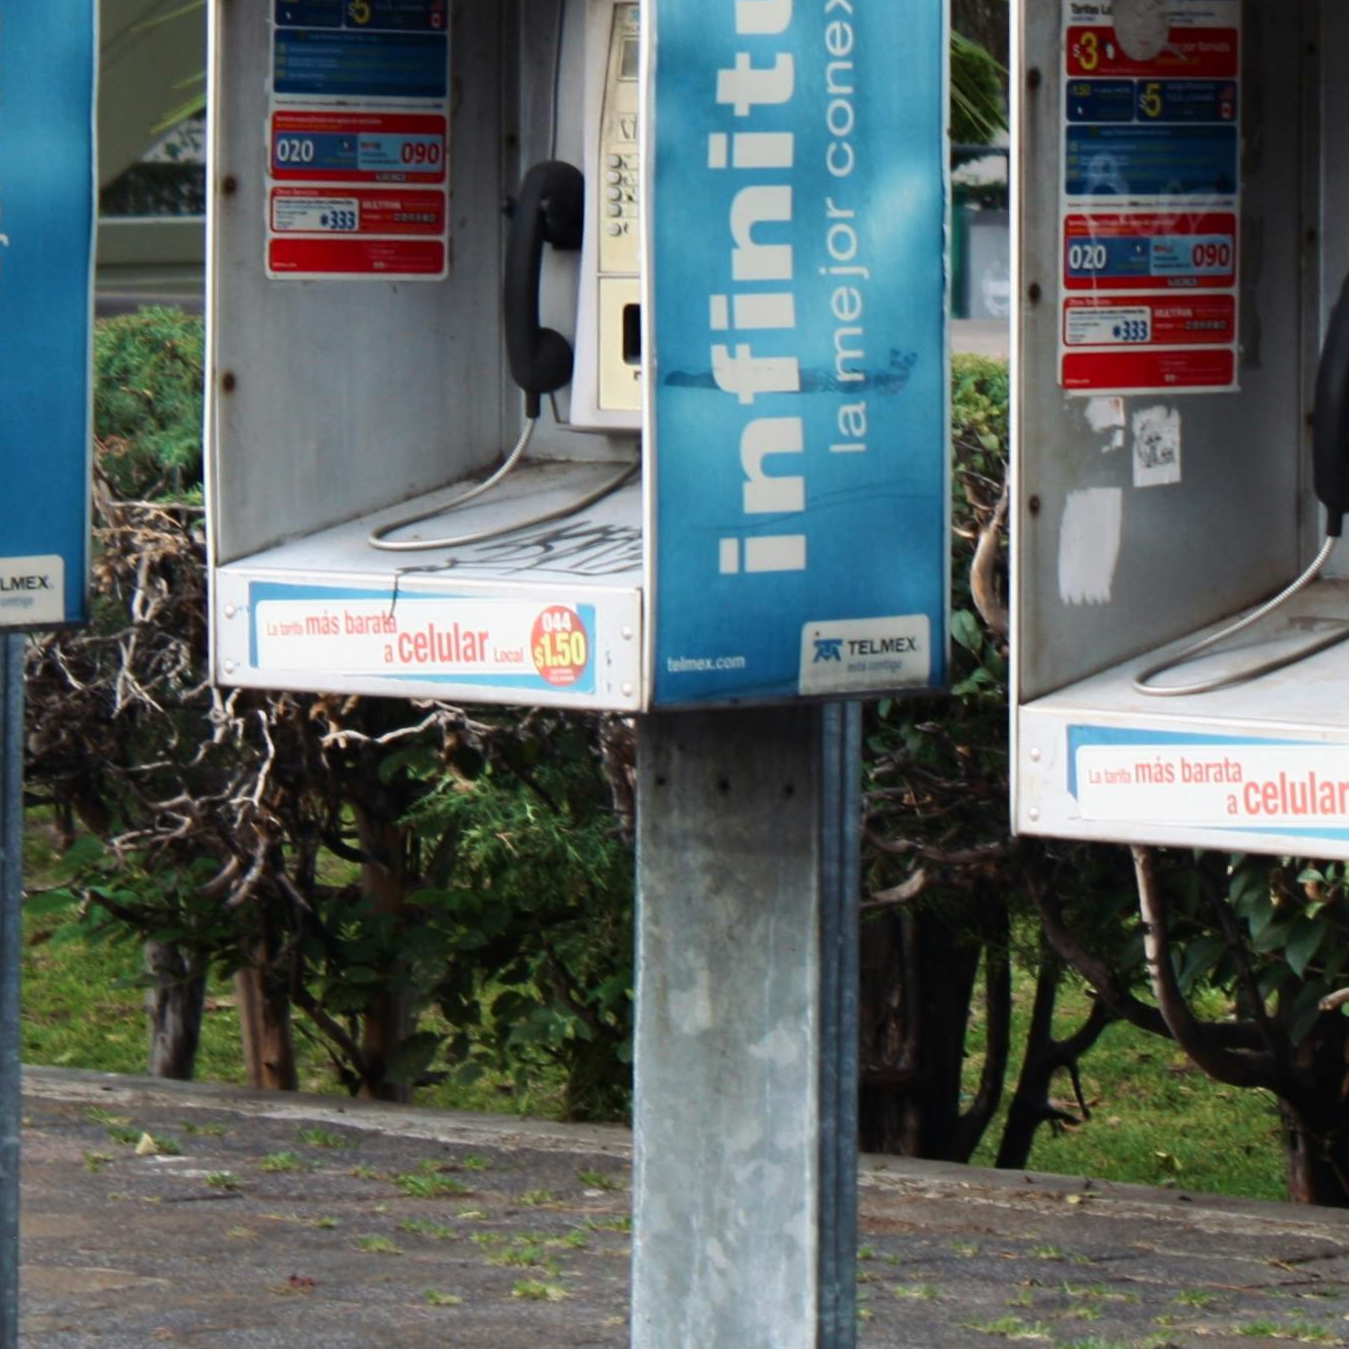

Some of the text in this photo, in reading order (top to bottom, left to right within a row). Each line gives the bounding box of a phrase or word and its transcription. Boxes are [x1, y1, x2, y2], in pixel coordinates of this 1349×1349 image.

[277, 139, 314, 162] 020
[402, 142, 440, 164] 090
[1069, 244, 1106, 270] 020
[1193, 243, 1231, 268] 090
[819, 196, 869, 382] mejor
[830, 402, 867, 453] la
[305, 610, 340, 635] más
[345, 610, 397, 635] barata
[542, 612, 572, 632] 044
[384, 622, 524, 663] a celular Local
[534, 631, 586, 668] $1.50
[847, 637, 917, 657] TELMEX
[667, 656, 746, 673] telmex.com
[1134, 756, 1175, 784] más
[1180, 757, 1243, 784] barata
[1226, 793, 1238, 815] a
